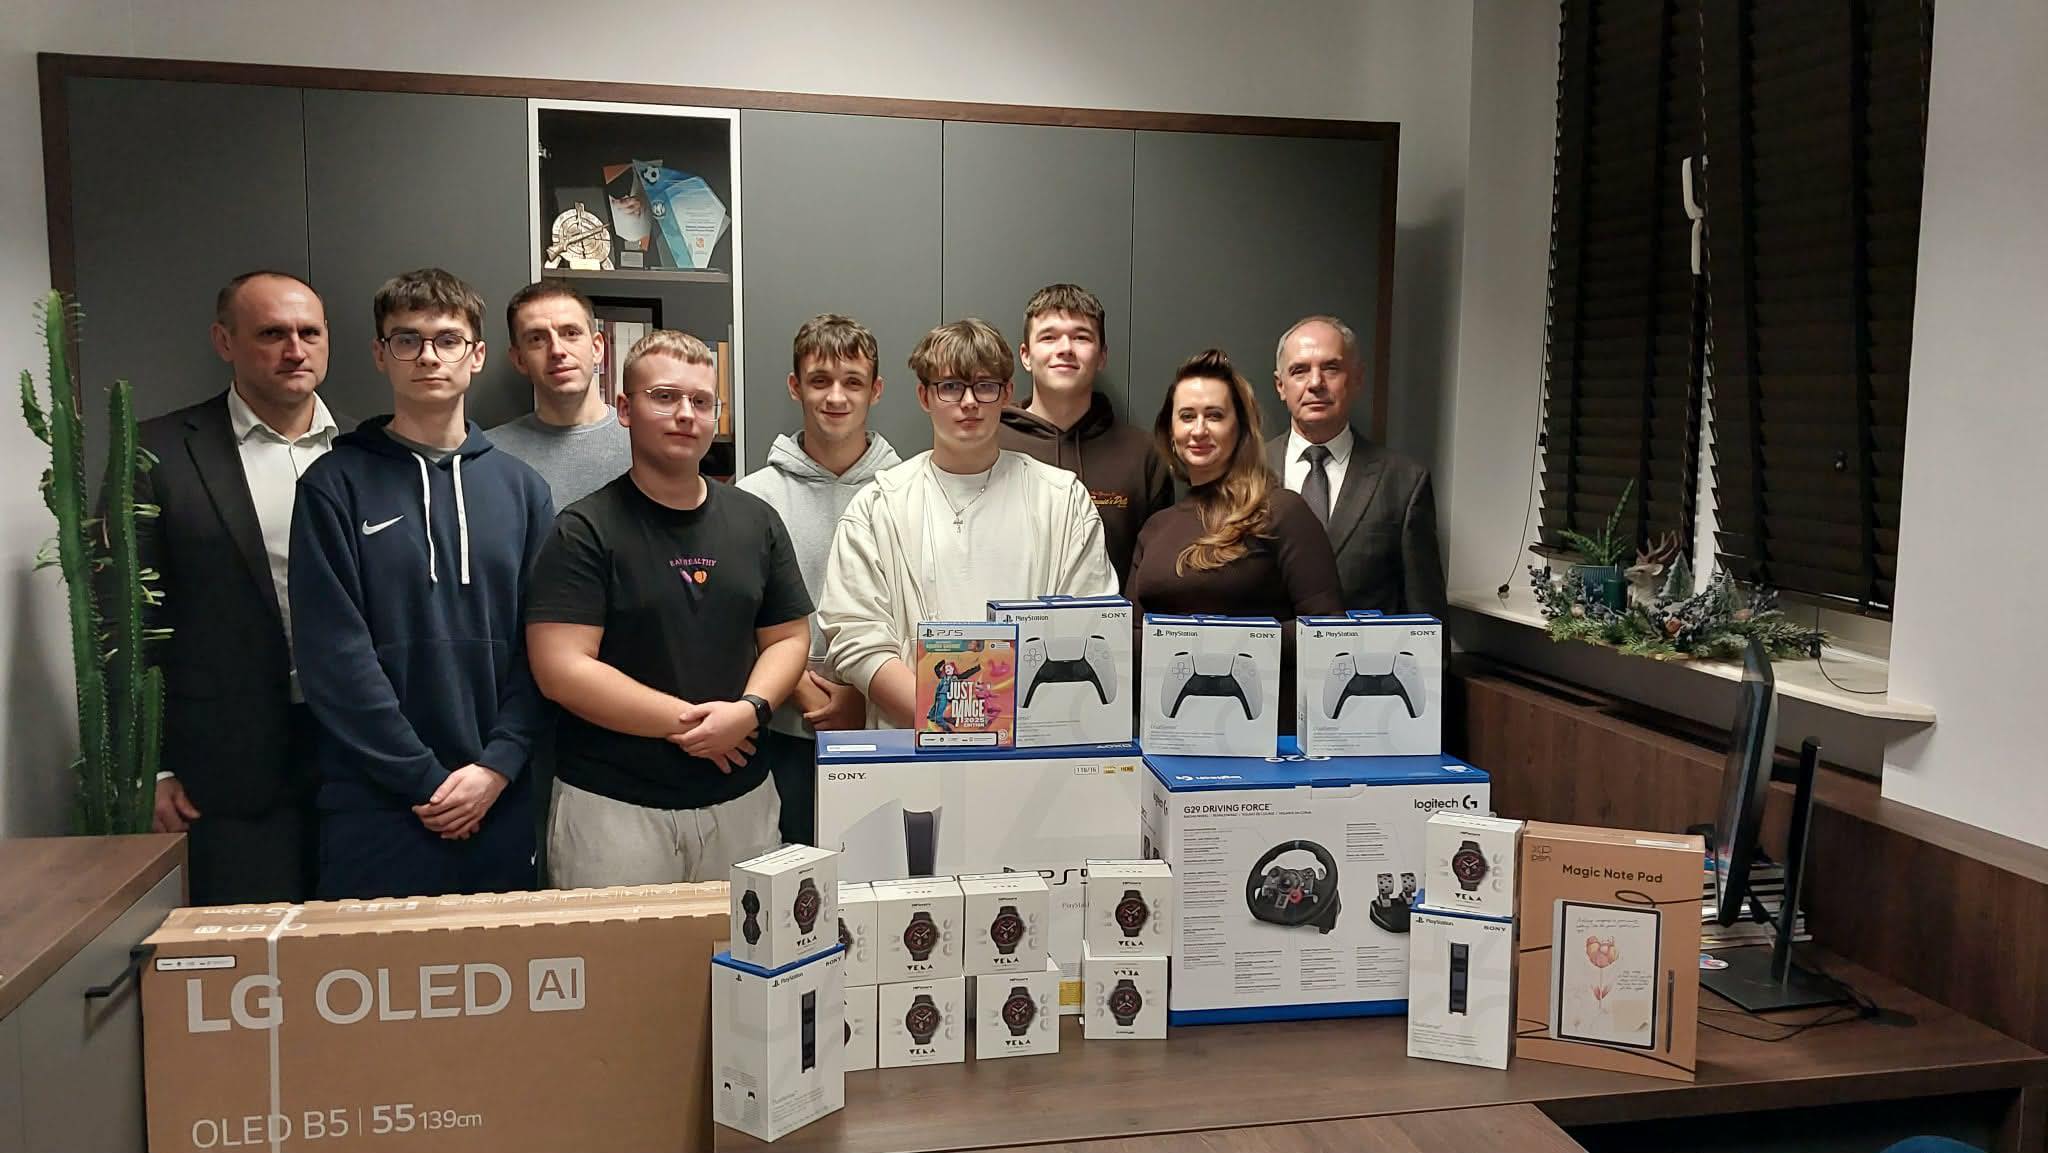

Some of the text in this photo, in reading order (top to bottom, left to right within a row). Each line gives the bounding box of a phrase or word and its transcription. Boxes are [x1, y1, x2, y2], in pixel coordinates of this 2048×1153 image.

[1015, 614, 1049, 623] PlayStation
[937, 629, 964, 637] PS5
[1165, 629, 1198, 638] PlayStation
[1325, 630, 1359, 638] PlayStation
[947, 681, 975, 700] JUST
[952, 700, 985, 719] DANCE
[828, 772, 867, 781] SONY
[1184, 805, 1201, 814] G29
[1203, 804, 1239, 813] DRIVING
[1414, 798, 1459, 813] logitech
[1563, 864, 1663, 884] Magic Note Pad
[825, 956, 841, 967] SONY
[186, 962, 579, 1034] LG OLED AI
[192, 1105, 482, 1150] OLED B5 55 139cm
